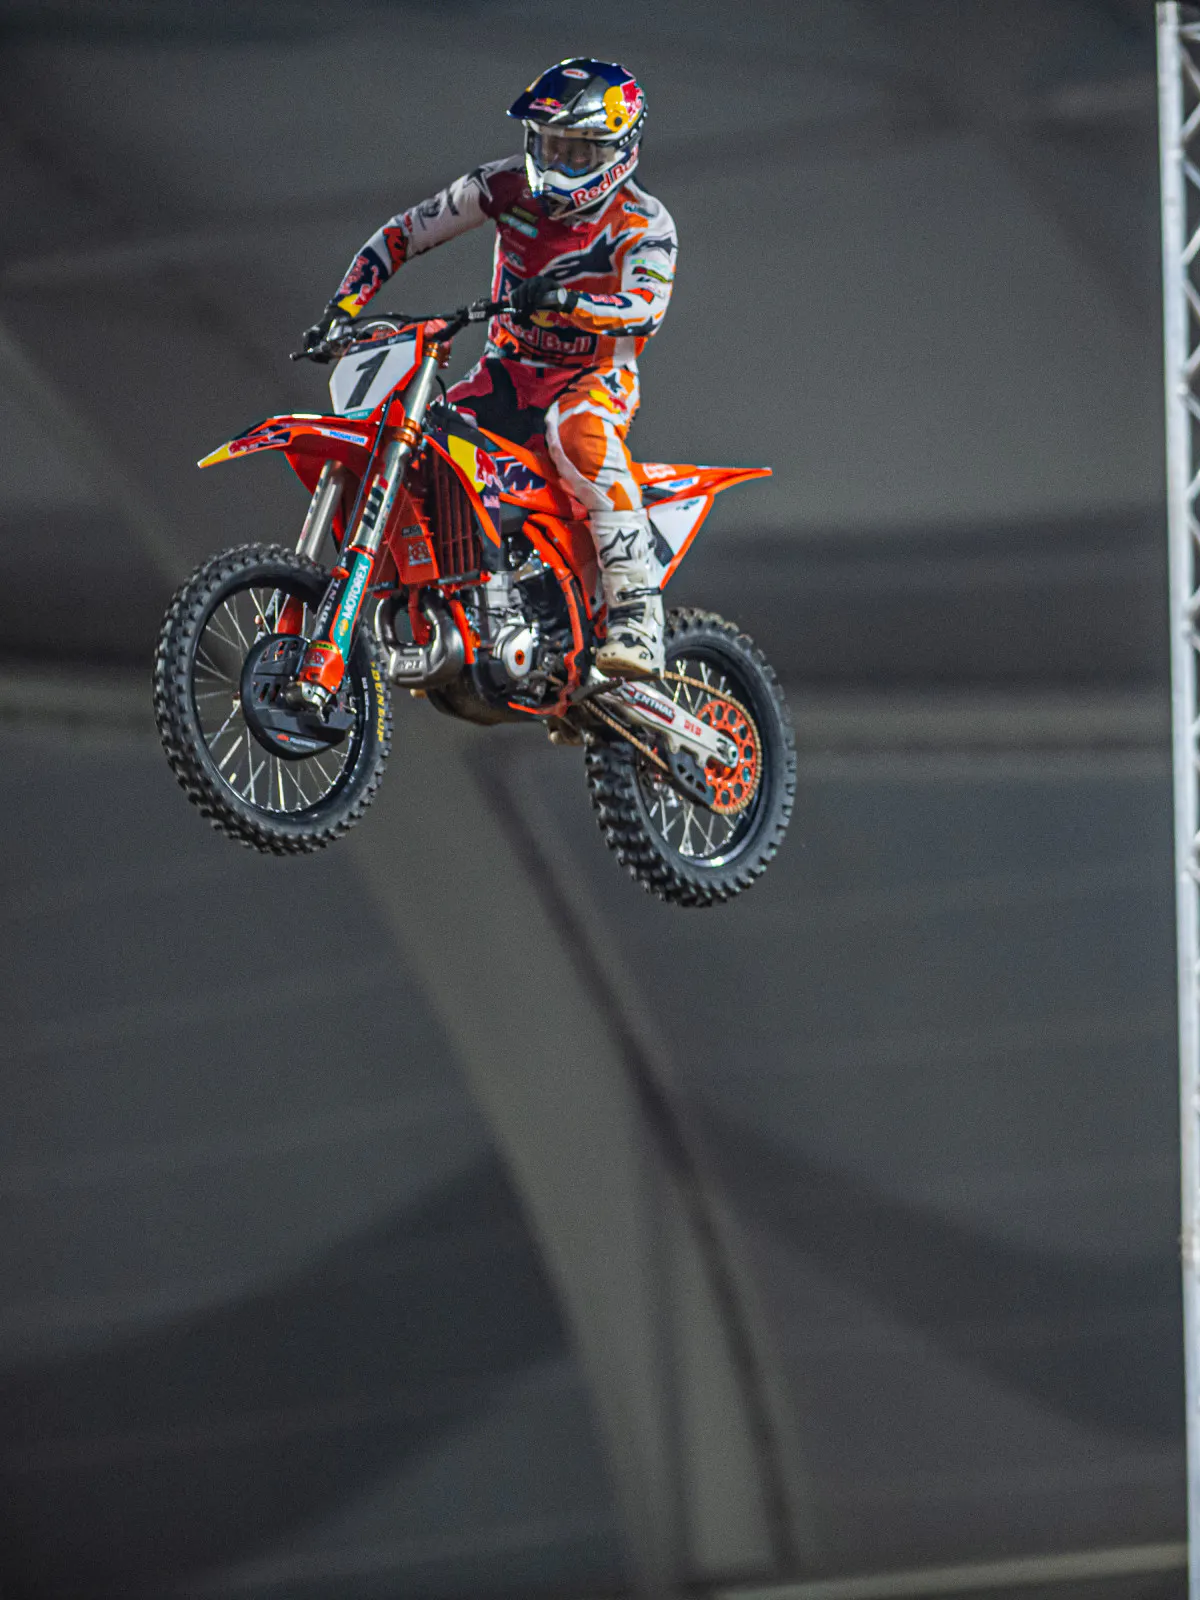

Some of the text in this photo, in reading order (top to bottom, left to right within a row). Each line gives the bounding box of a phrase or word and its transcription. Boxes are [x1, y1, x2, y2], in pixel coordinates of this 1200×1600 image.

[570, 173, 612, 208] Red
[541, 329, 592, 352] Bull
[344, 349, 391, 410] 1
[341, 562, 369, 620] MOTOREX
[370, 669, 386, 743] DUNLOP
